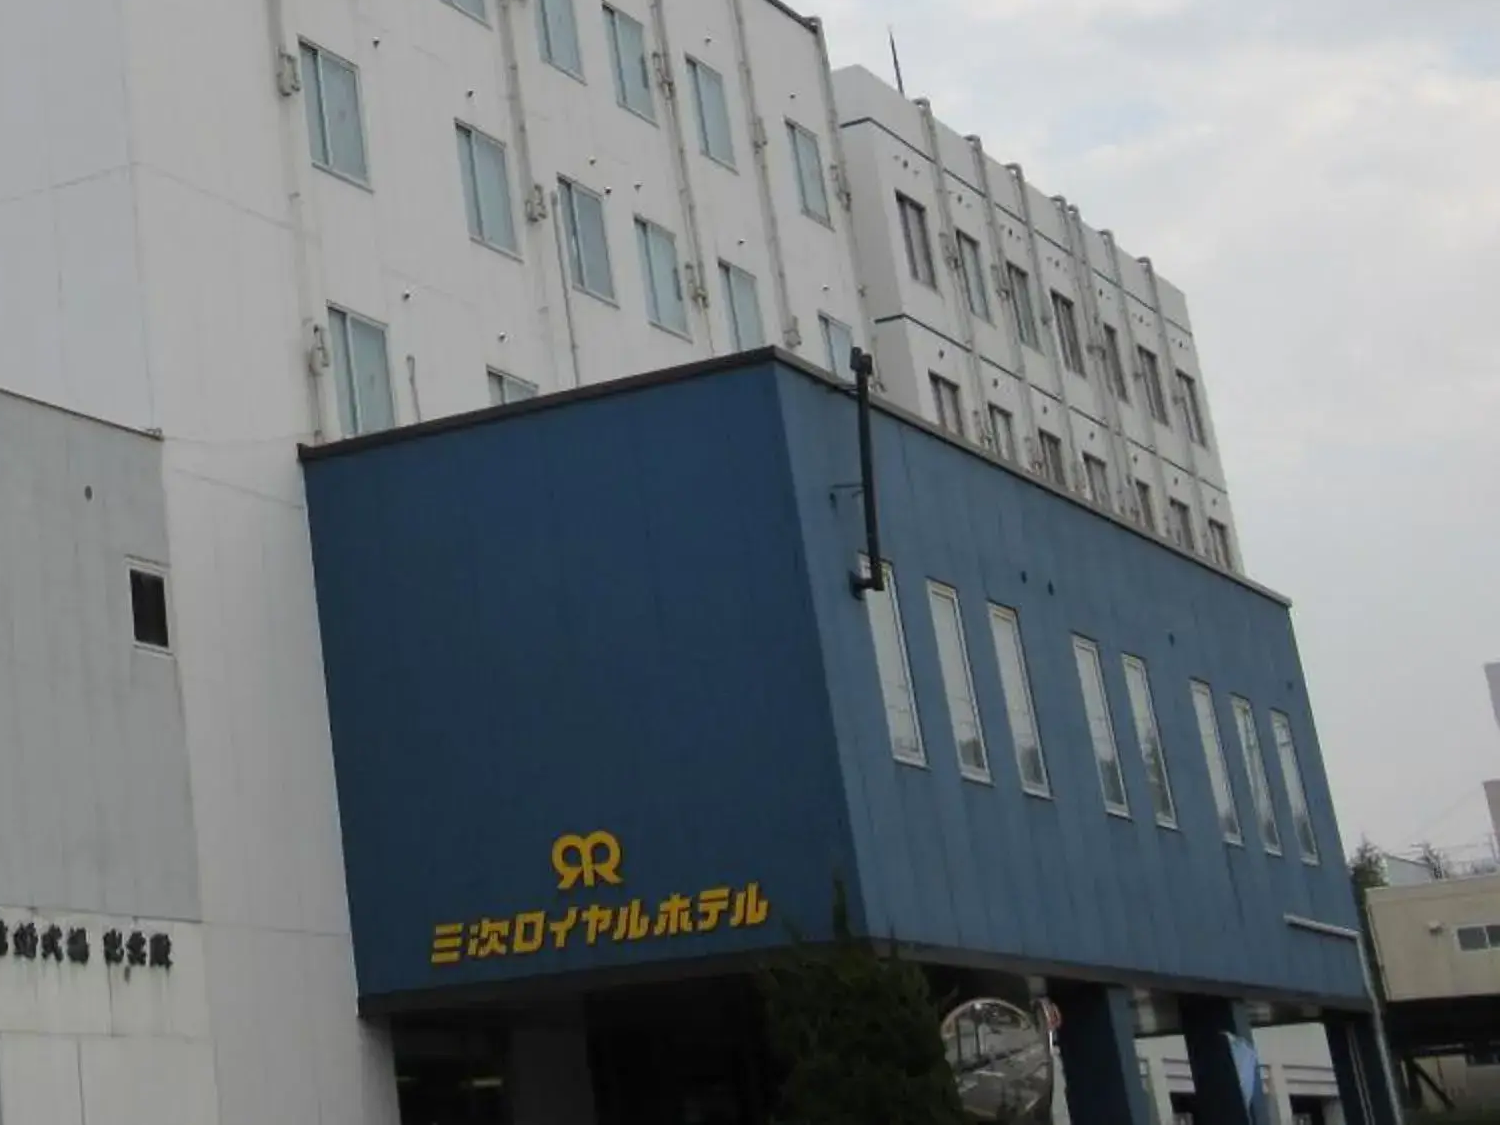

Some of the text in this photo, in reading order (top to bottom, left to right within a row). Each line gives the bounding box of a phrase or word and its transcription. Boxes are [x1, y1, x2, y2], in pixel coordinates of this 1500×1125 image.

[430, 882, 769, 964] 三次ロイヤルホテル
